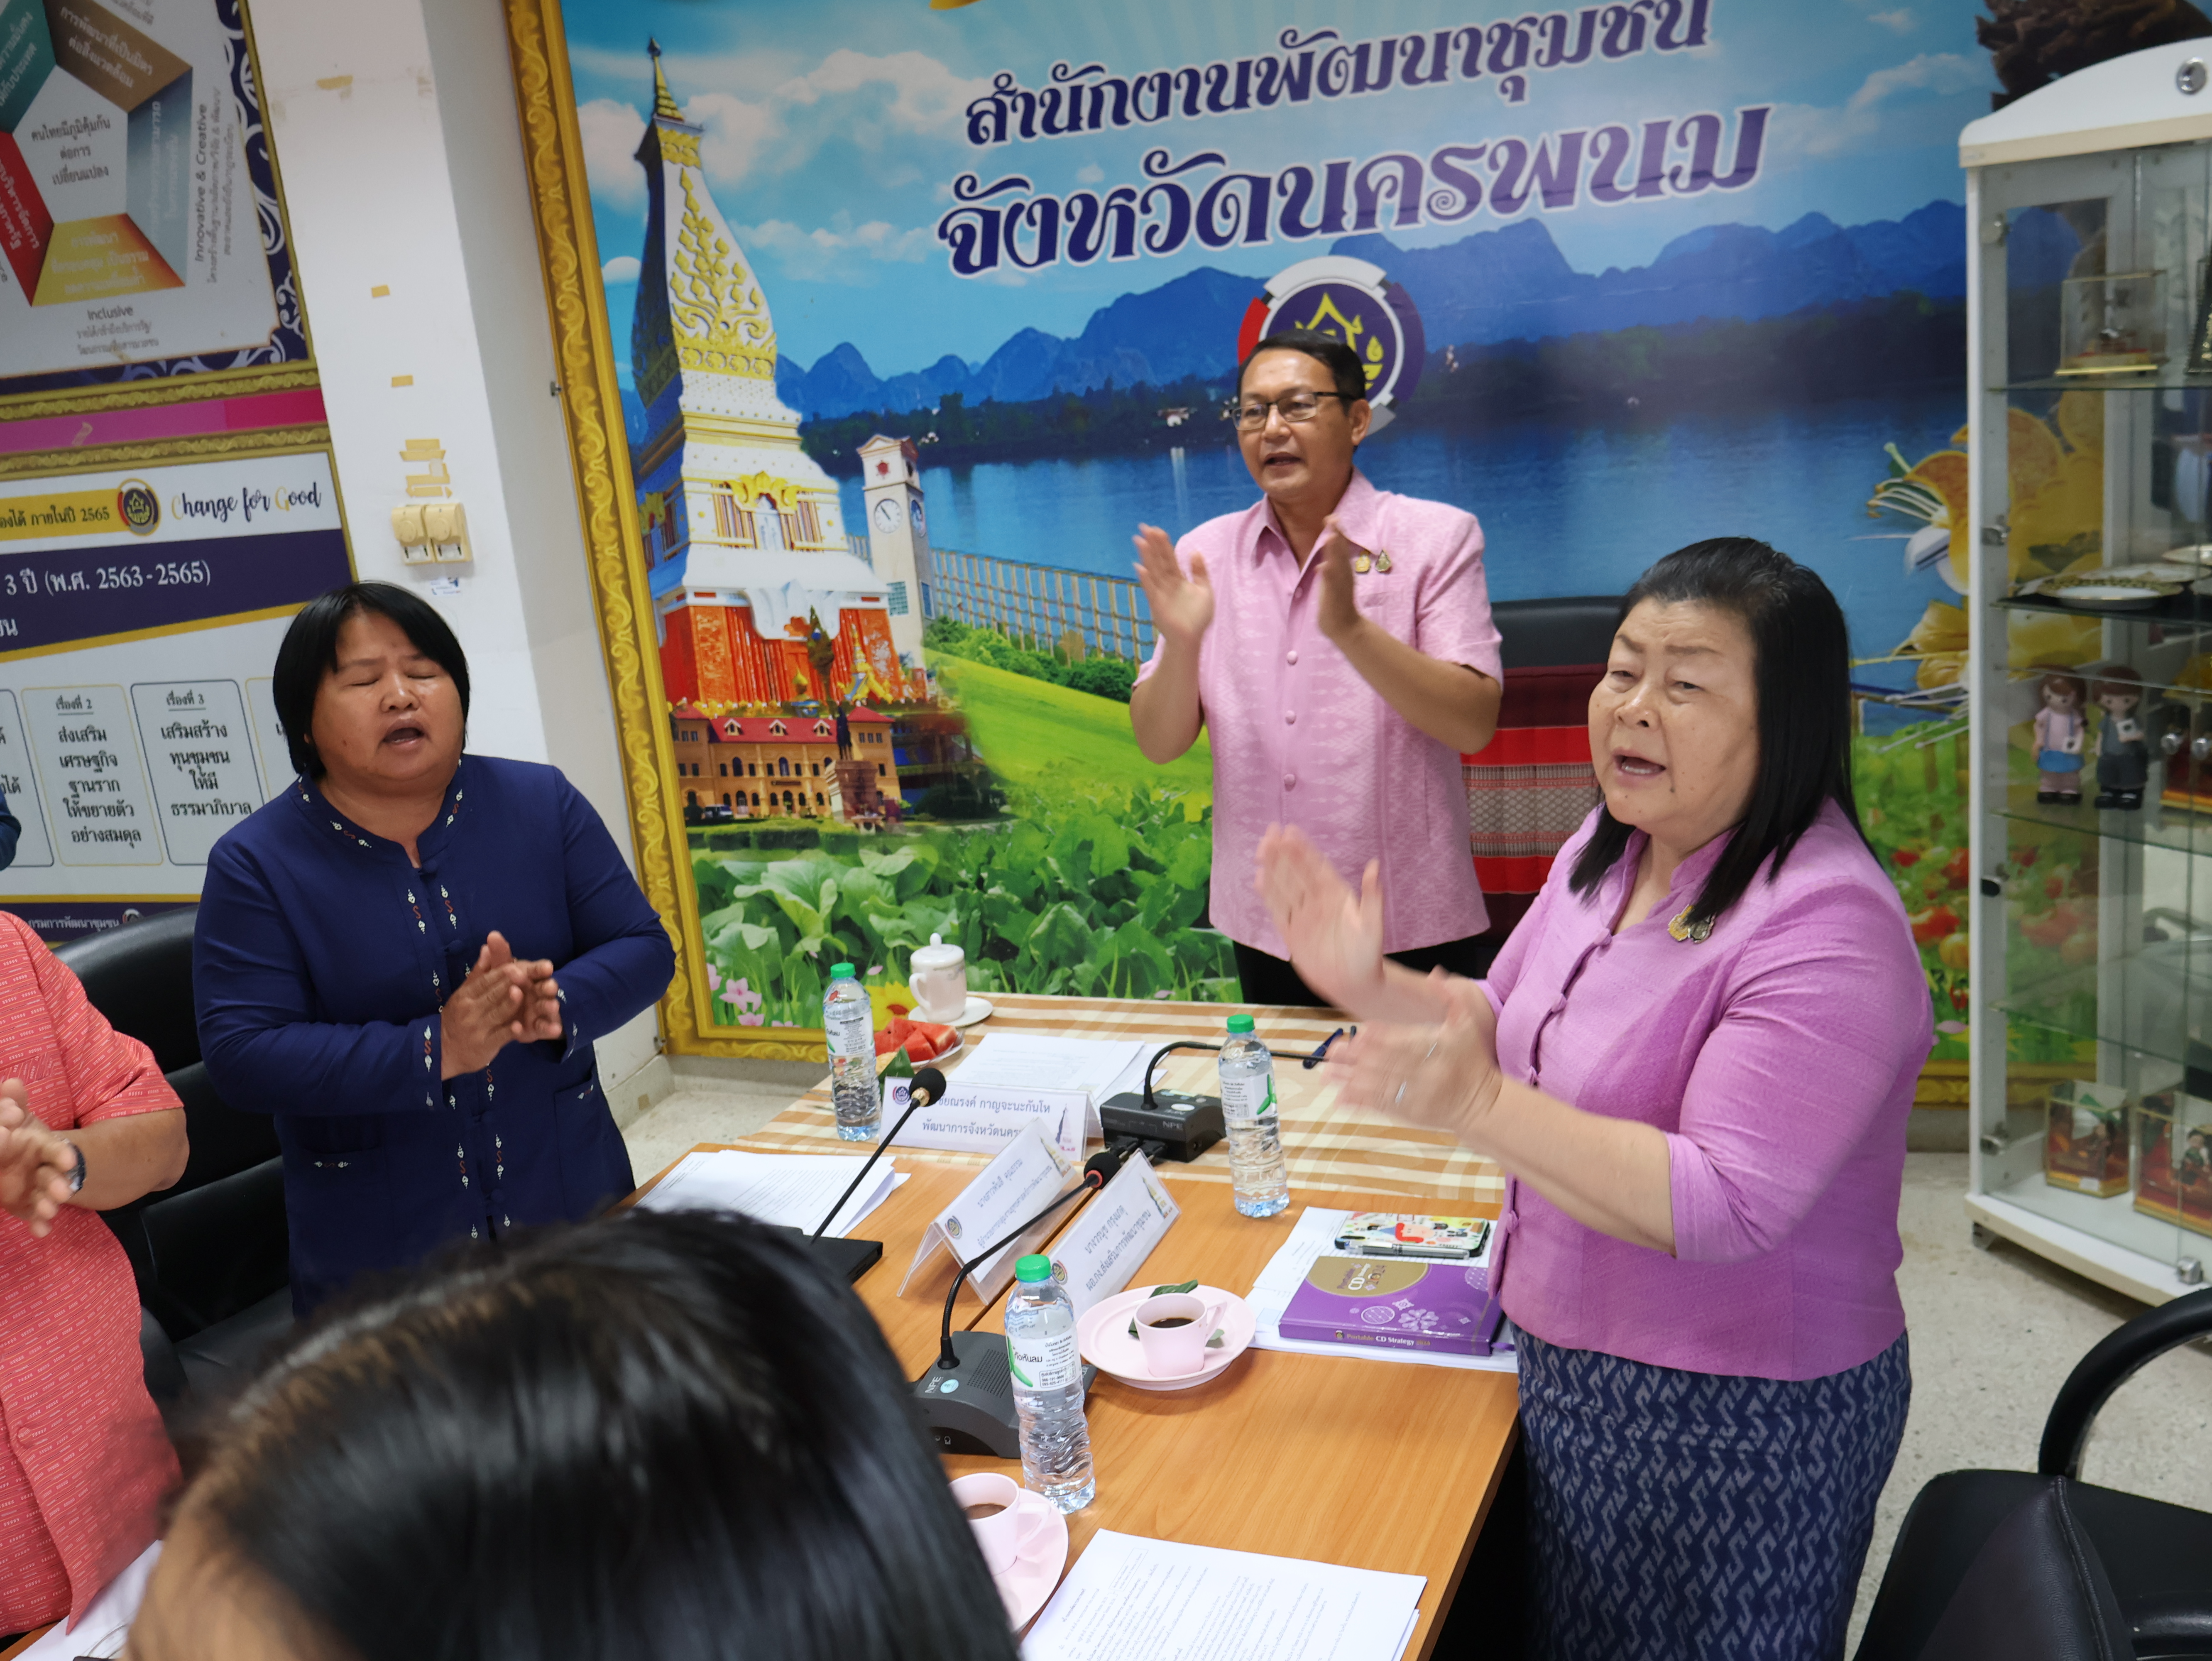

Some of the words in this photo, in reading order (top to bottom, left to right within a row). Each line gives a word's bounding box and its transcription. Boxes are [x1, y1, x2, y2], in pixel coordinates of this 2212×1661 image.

[966, 0, 1711, 146] สำนักงานพัฒนาชุมชน
[196, 104, 207, 165] Creative
[939, 105, 1772, 276] จังหวัดนครพนม
[87, 306, 133, 320] Inclusive
[171, 492, 237, 523] Change
[243, 487, 271, 522] for
[275, 482, 322, 511] Good
[81, 506, 110, 522] 2565
[6, 574, 17, 595] 3
[20, 567, 37, 595] ปี
[45, 570, 90, 596] (พ.ศ.
[86, 698, 92, 709] 2
[198, 694, 205, 705] 3
[58, 725, 107, 742] ส่งเสริม
[161, 719, 228, 739] เสริมสร้าง
[59, 750, 118, 773] เศรษฐกิจ
[169, 751, 230, 777] ทุนชุมชน
[189, 768, 218, 789] ให้มี
[69, 779, 120, 799] ฐานราก
[63, 797, 135, 818] ให้ขยายตัว
[171, 798, 252, 816] ธรรมาภิบาล
[71, 825, 142, 848] อย่างสมดุล
[938, 1094, 977, 1108] ชัยณรงค์
[922, 1118, 1021, 1138] พัฒนาการจังหวัดนคร
[1388, 1336, 1415, 1346] Strategy
[925, 1376, 942, 1393] NPE
